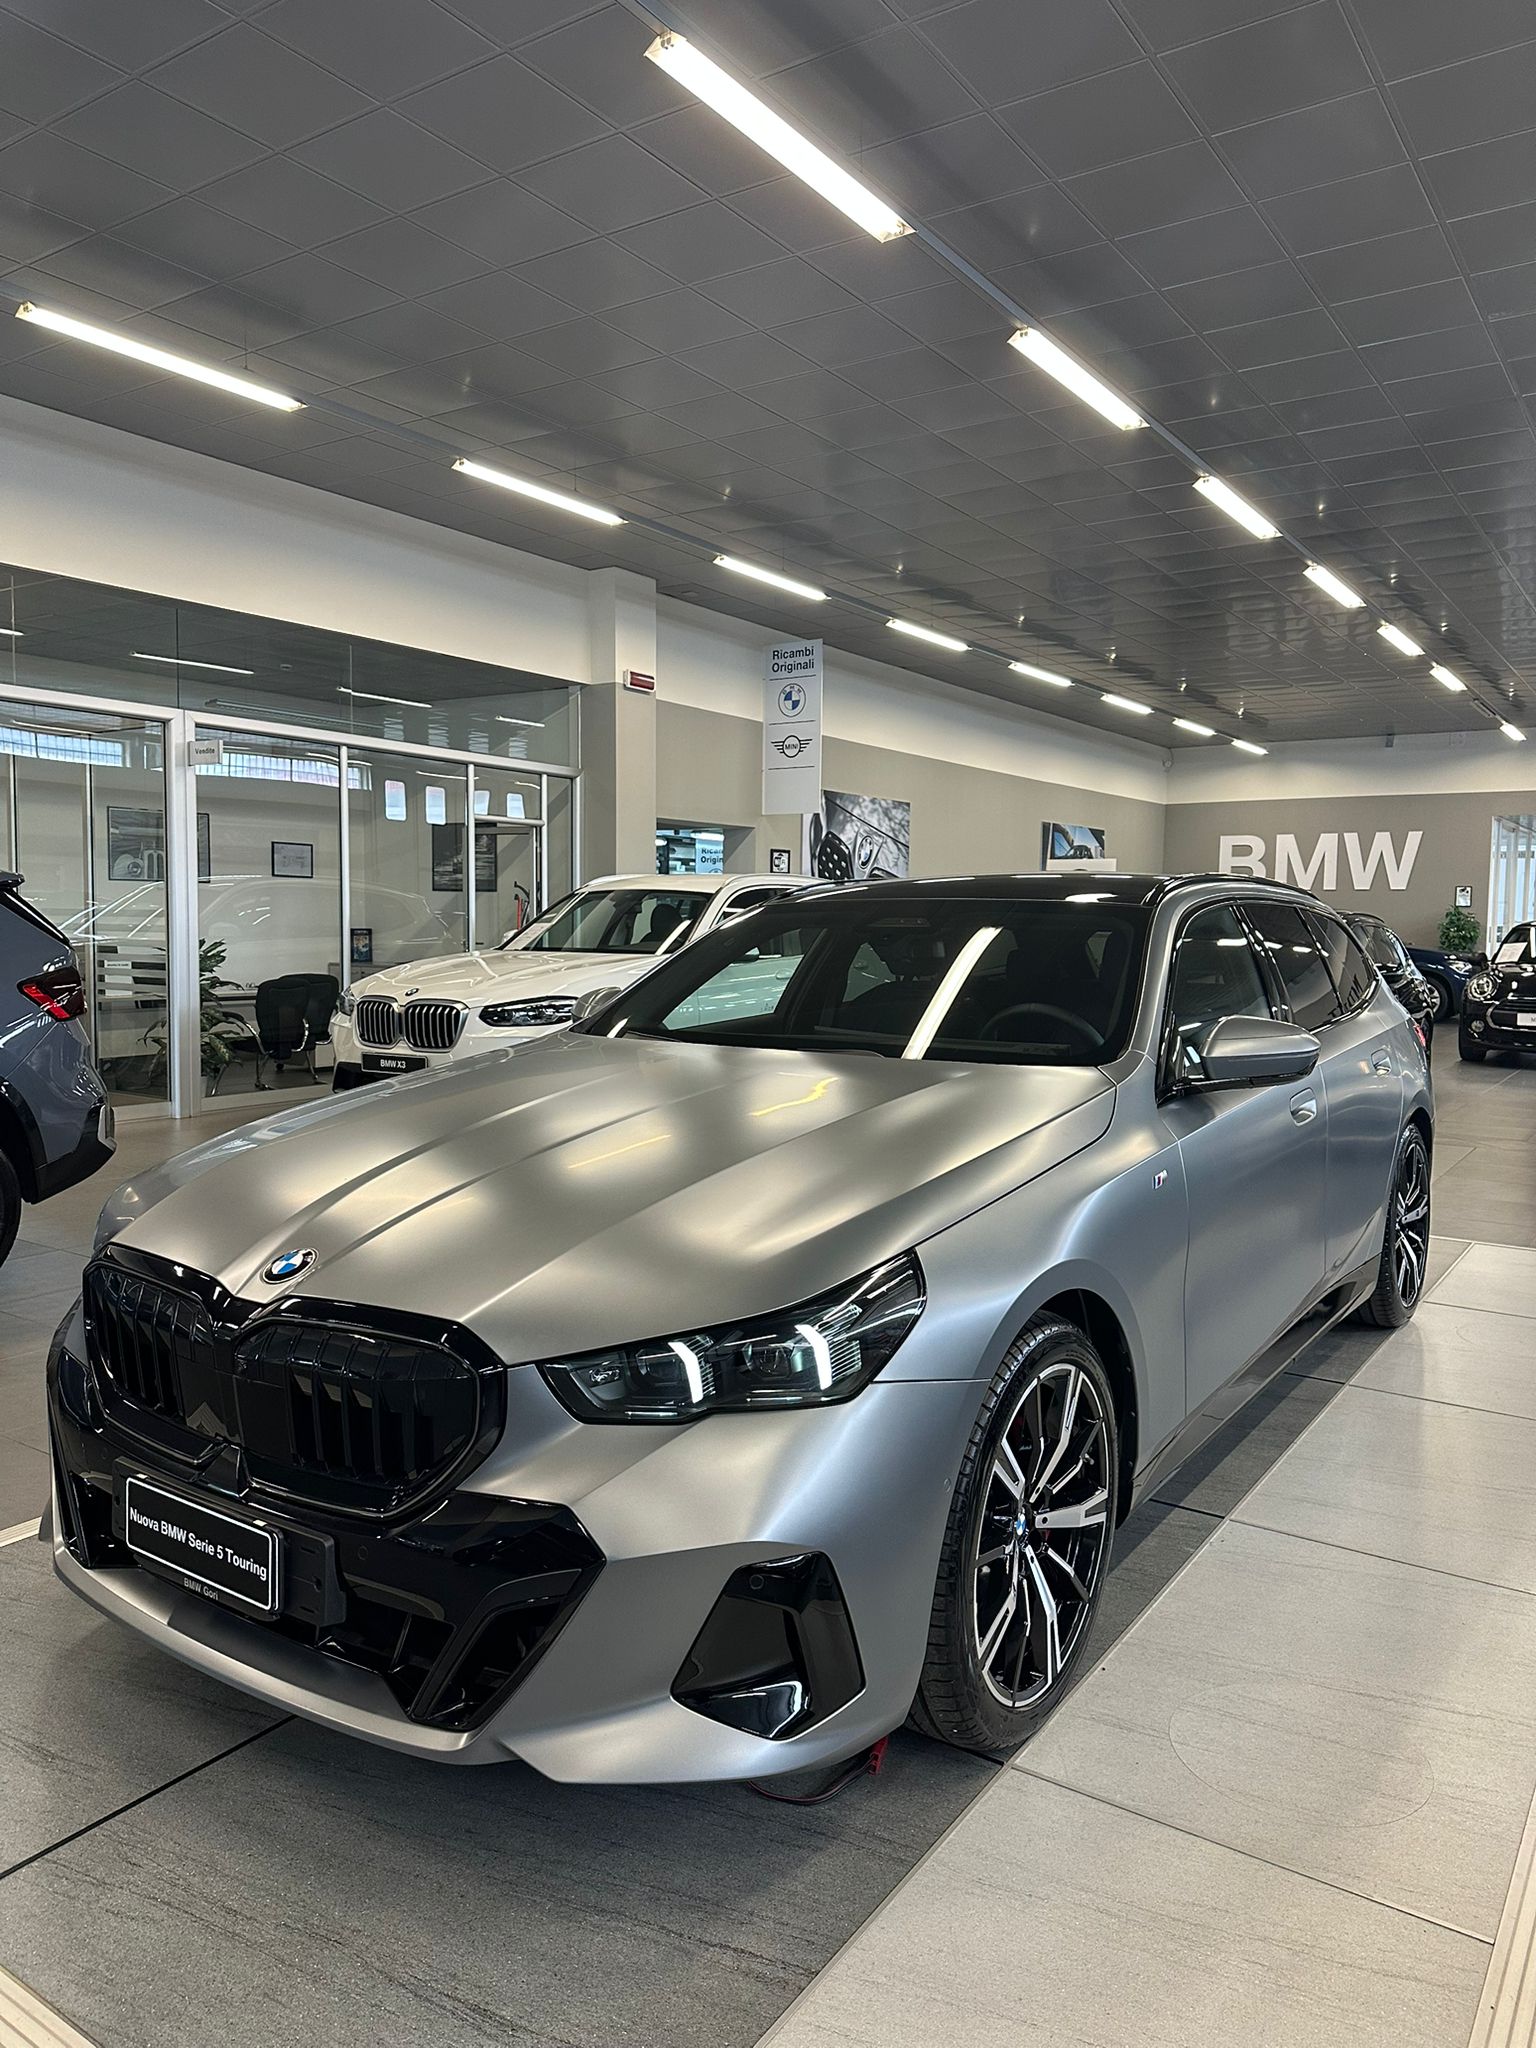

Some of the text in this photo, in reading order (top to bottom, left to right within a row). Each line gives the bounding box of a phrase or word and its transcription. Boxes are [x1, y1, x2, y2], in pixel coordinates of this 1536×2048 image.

[772, 646, 814, 660] Ricambi
[772, 659, 815, 673] Originali
[1219, 831, 1424, 890] BMW
[380, 1059, 406, 1069] BMW X3
[129, 1507, 267, 1581] Nuova BMW Serie 5 Touring
[184, 1577, 219, 1600] BMW Gori
